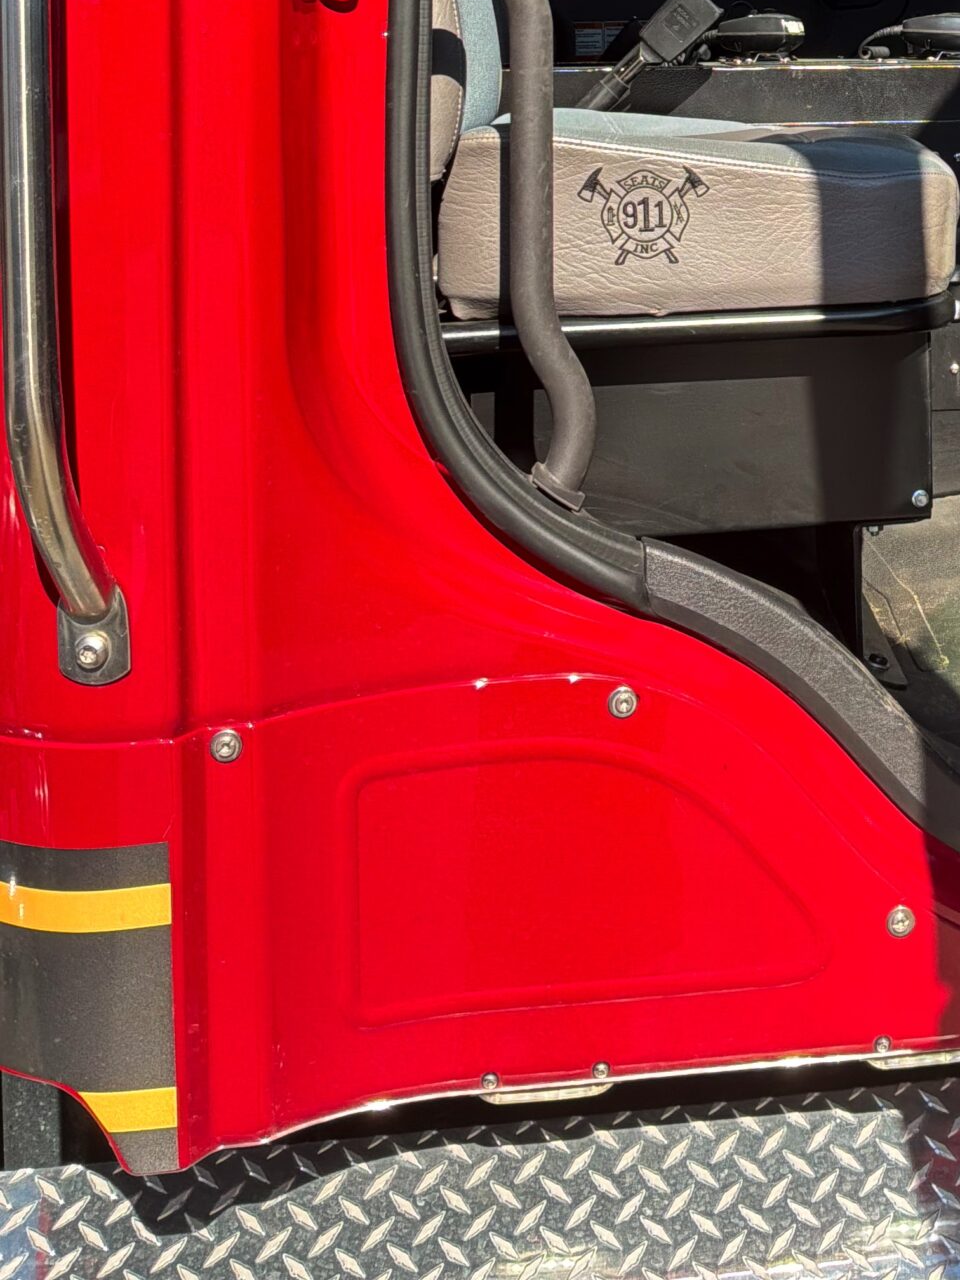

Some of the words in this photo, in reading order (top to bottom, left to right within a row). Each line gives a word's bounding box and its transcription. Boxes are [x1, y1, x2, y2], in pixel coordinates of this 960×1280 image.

[624, 175, 665, 189] SEATS
[622, 197, 667, 232] 911
[634, 242, 659, 254] INC
